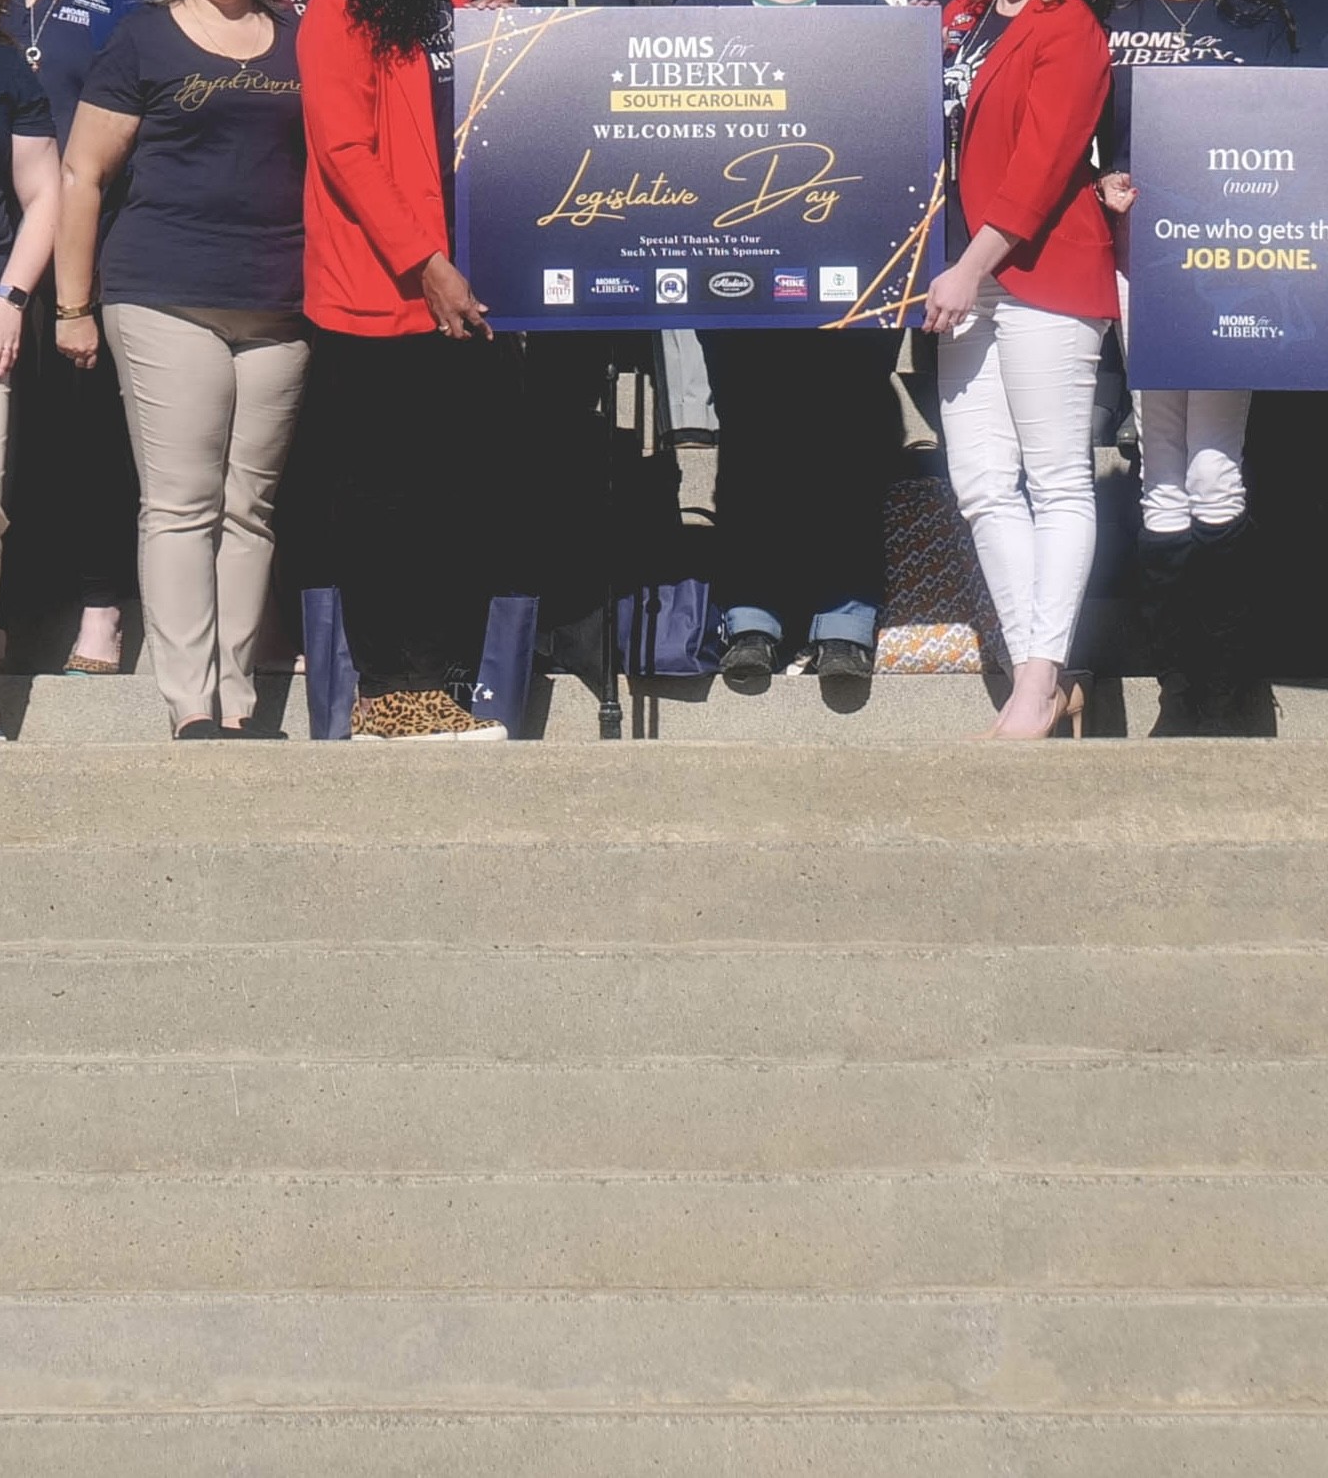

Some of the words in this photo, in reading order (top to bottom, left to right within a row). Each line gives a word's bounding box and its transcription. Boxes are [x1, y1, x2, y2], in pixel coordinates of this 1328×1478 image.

[1108, 31, 1186, 49] MOMS
[628, 36, 714, 58] MOMS
[716, 35, 755, 65] for
[628, 62, 771, 87] LIBERTY
[623, 94, 682, 108] SOUTH
[686, 93, 774, 108] CAROLINA
[593, 124, 717, 139] WELCOMES
[724, 123, 770, 138] YOU
[777, 123, 807, 138] TO
[1208, 148, 1296, 171] mom
[536, 149, 700, 226] Legislative
[713, 142, 863, 228] Day
[1222, 178, 1279, 196] (noun)
[639, 235, 678, 247] Special
[681, 234, 720, 244] Thanks
[722, 234, 737, 244] To
[740, 234, 761, 244] Our
[1155, 219, 1200, 239] One
[1204, 219, 1253, 239] who
[1258, 221, 1304, 244] gets
[620, 247, 646, 257] Such
[648, 247, 657, 257] A
[660, 247, 687, 257] Time
[690, 247, 703, 257] As
[706, 247, 729, 257] This
[732, 247, 781, 258] Sponsors
[1181, 249, 1230, 270] JOB
[1237, 248, 1317, 270] DONE.
[596, 284, 636, 294] LIBERTY
[1219, 315, 1254, 326] MOMS
[1255, 315, 1272, 328] for
[1219, 326, 1278, 339] LIBERTY
